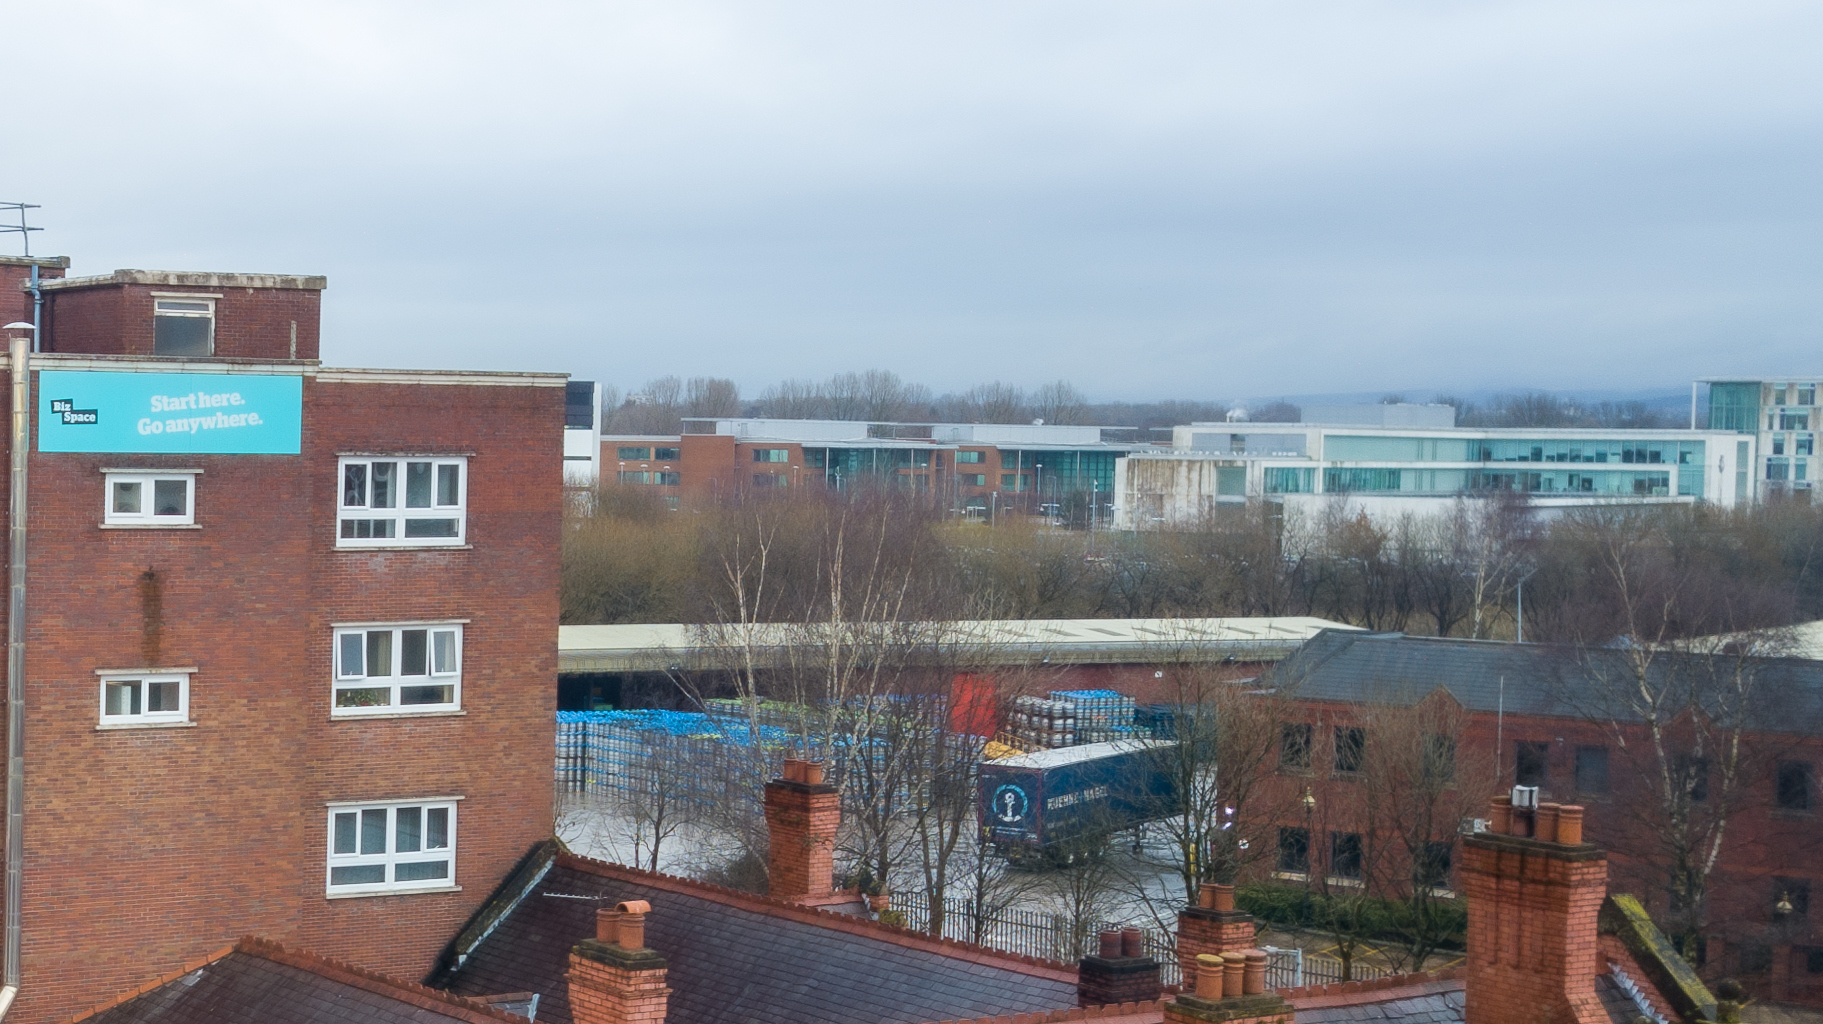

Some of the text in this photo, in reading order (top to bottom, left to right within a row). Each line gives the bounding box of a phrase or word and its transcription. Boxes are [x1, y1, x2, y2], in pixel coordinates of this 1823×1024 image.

[53, 401, 71, 411] Biz
[150, 391, 246, 412] Start here.
[64, 411, 96, 423] Space
[137, 412, 263, 435] Go anywhere.
